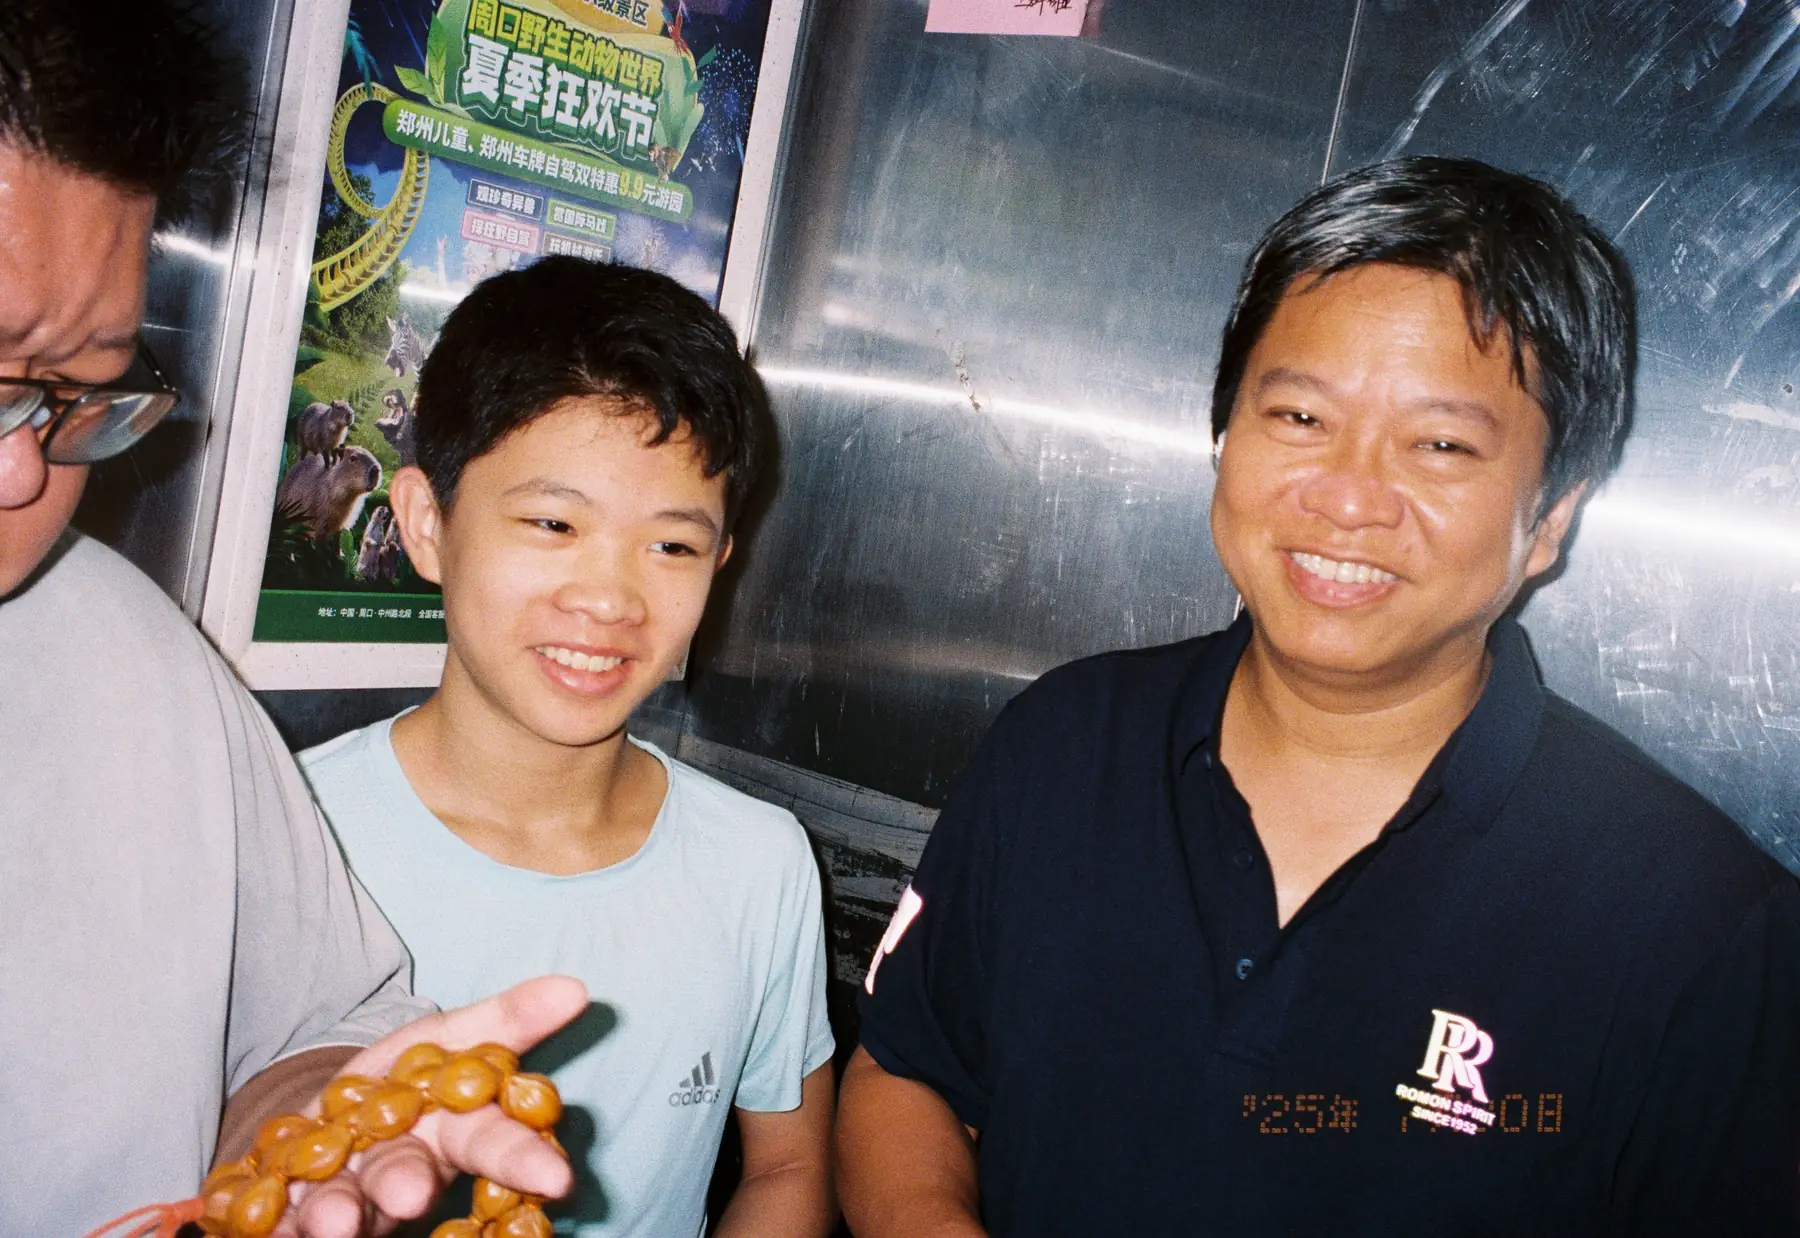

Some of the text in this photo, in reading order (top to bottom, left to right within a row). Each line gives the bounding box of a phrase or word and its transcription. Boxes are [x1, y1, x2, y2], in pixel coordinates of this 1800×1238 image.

[461, 33, 658, 149] 夏季狂欢节
[467, 0, 664, 94] 周口野生动物世界
